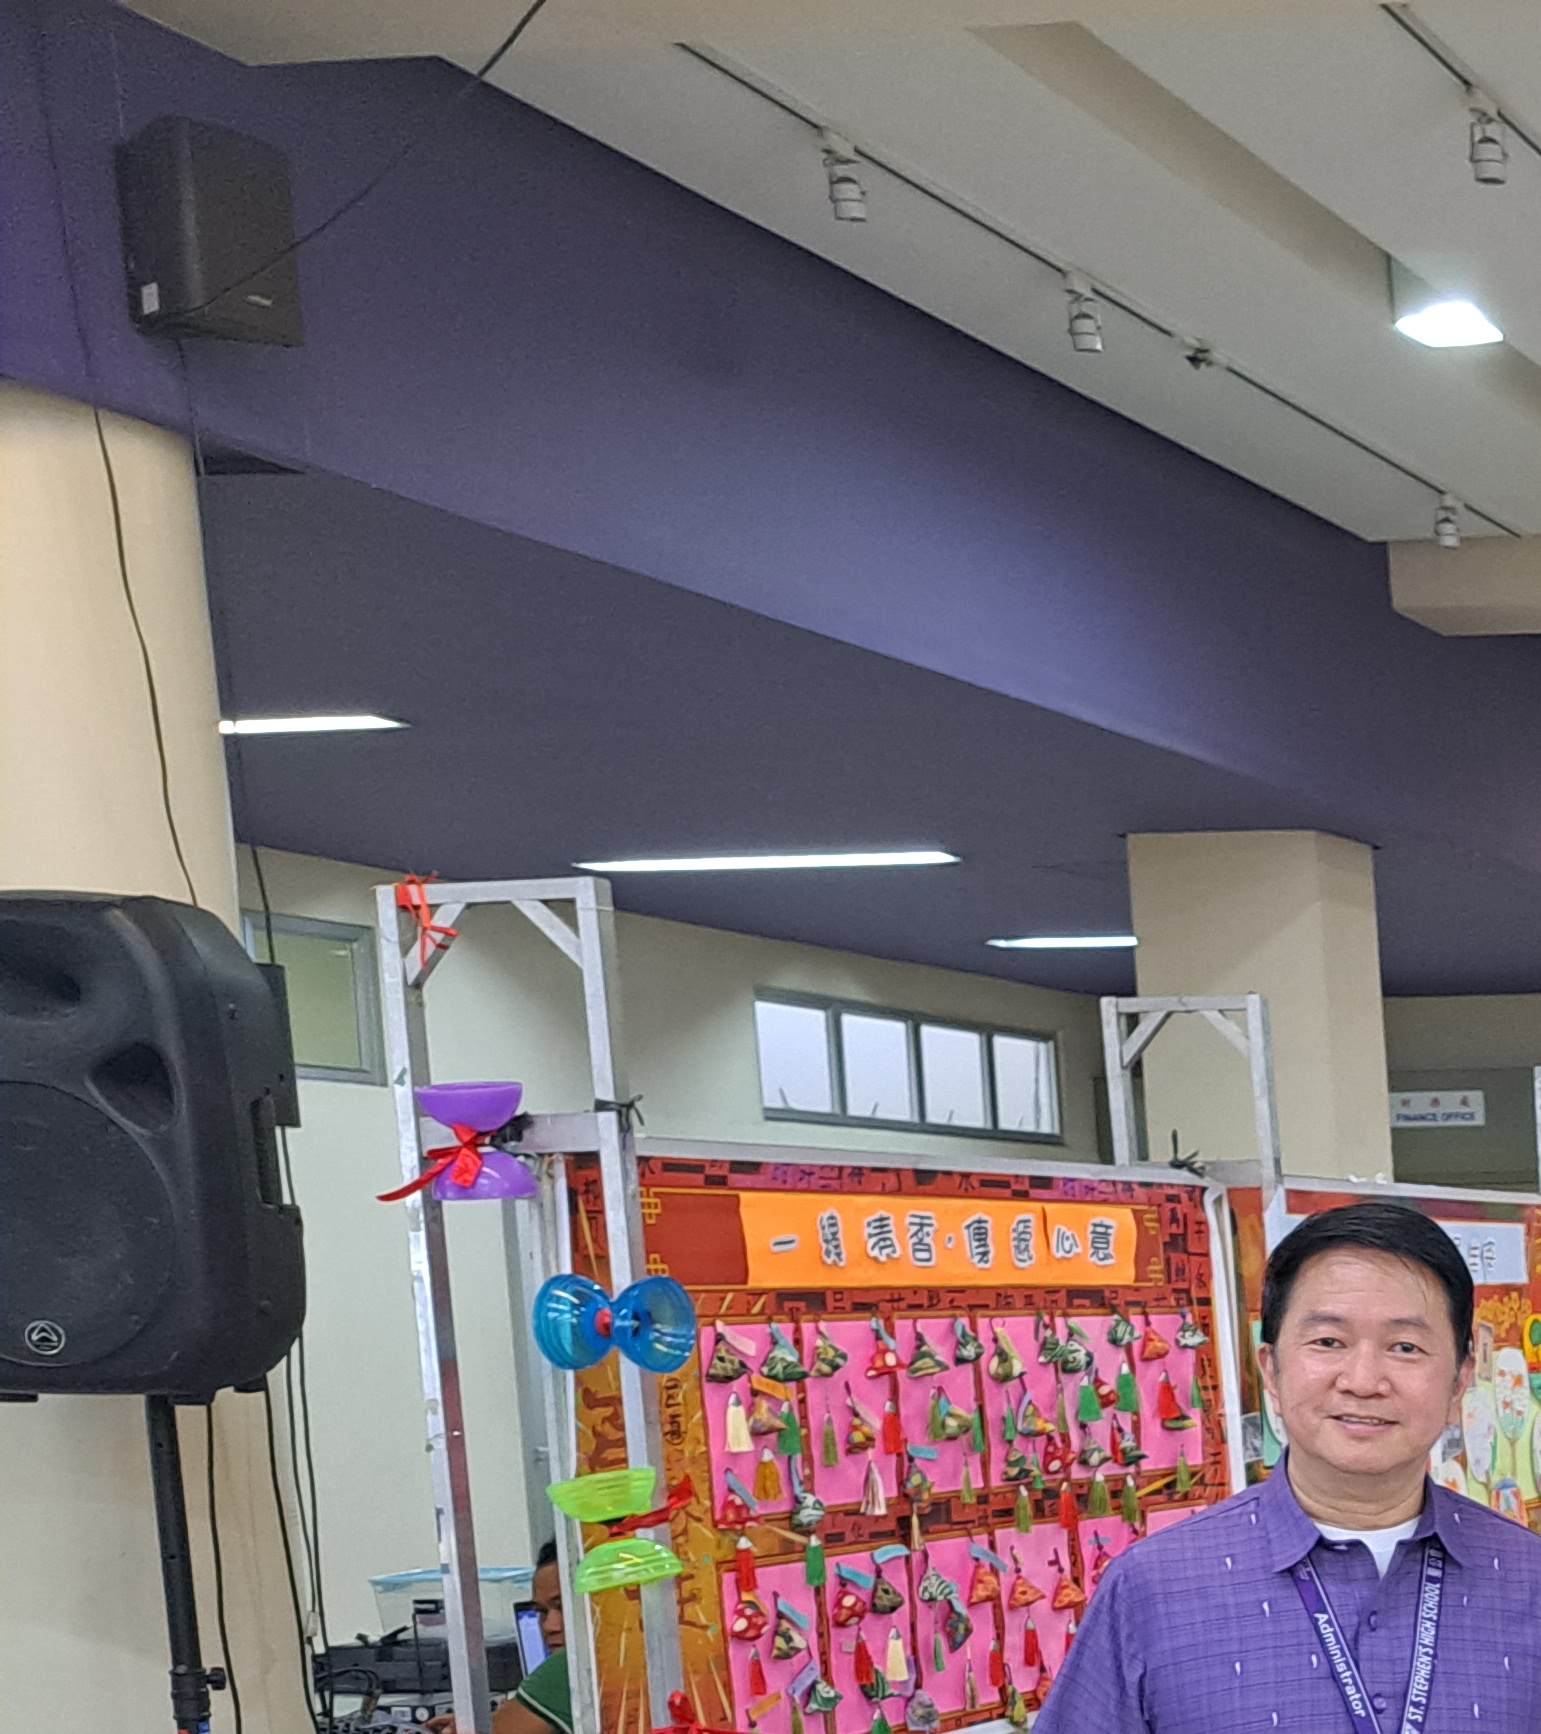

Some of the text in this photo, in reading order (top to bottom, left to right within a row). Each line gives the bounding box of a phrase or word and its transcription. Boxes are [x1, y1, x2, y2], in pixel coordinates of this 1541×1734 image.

[1419, 1619, 1437, 1647] HIGH
[1313, 1612, 1366, 1718] Administrator
[1410, 1645, 1434, 1705] STEPHEN'S
